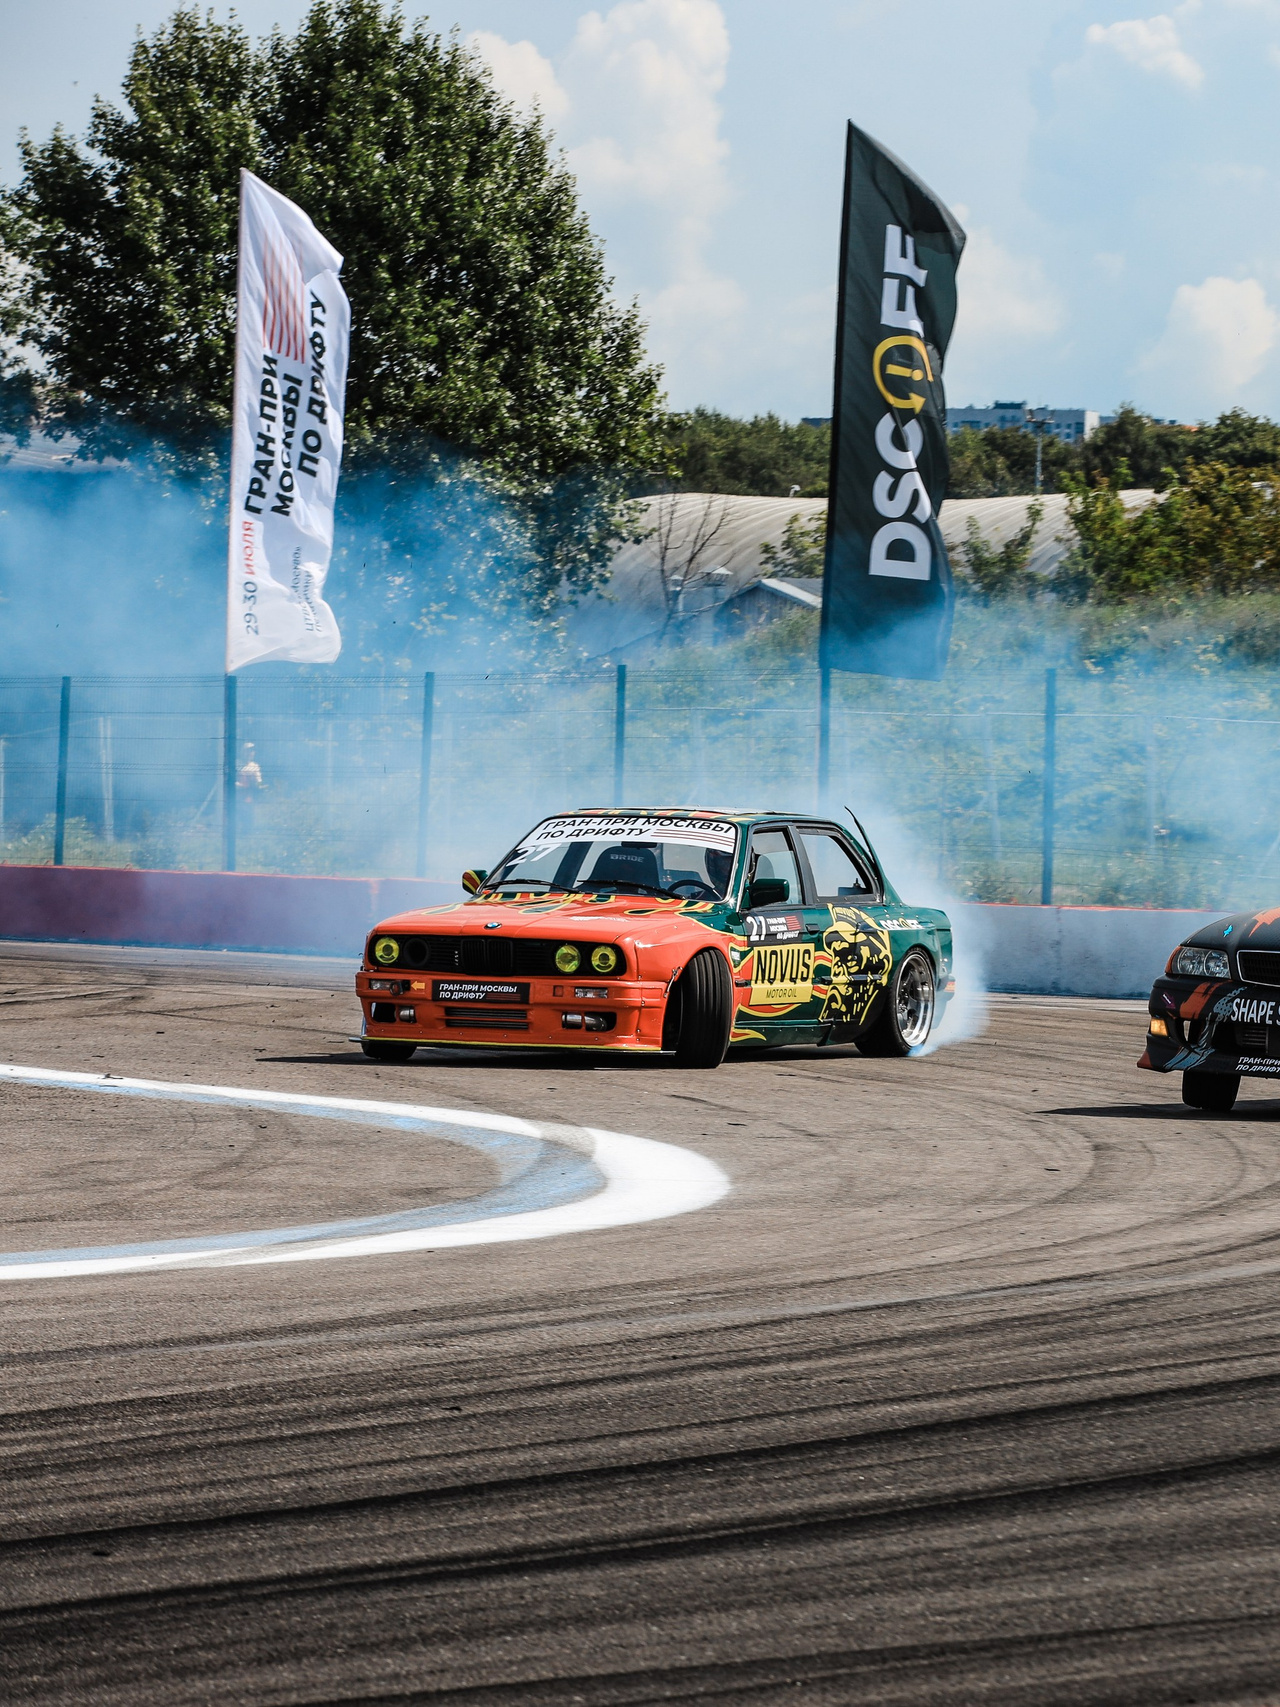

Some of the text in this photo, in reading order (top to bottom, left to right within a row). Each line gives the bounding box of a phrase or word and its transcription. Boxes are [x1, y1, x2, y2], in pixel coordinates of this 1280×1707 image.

[298, 289, 328, 478] ПО ДРИФТУ
[244, 354, 278, 515] ГРАН-ПРИ
[241, 520, 259, 636] 29-30 ИЮЛЯ
[536, 827, 652, 840] ПО ДРИФТУ
[543, 817, 733, 834] ГРАН-ПРИ МОСКВЫ
[506, 843, 562, 867] 27
[610, 853, 644, 863] BRIDE
[746, 915, 766, 941] 27
[755, 949, 812, 985] NOVUS
[439, 983, 517, 993] ГРАН-ПРИ МОСКВЫ
[452, 992, 485, 1000] ДРИФТУ
[1230, 997, 1275, 1024] SHAPE
